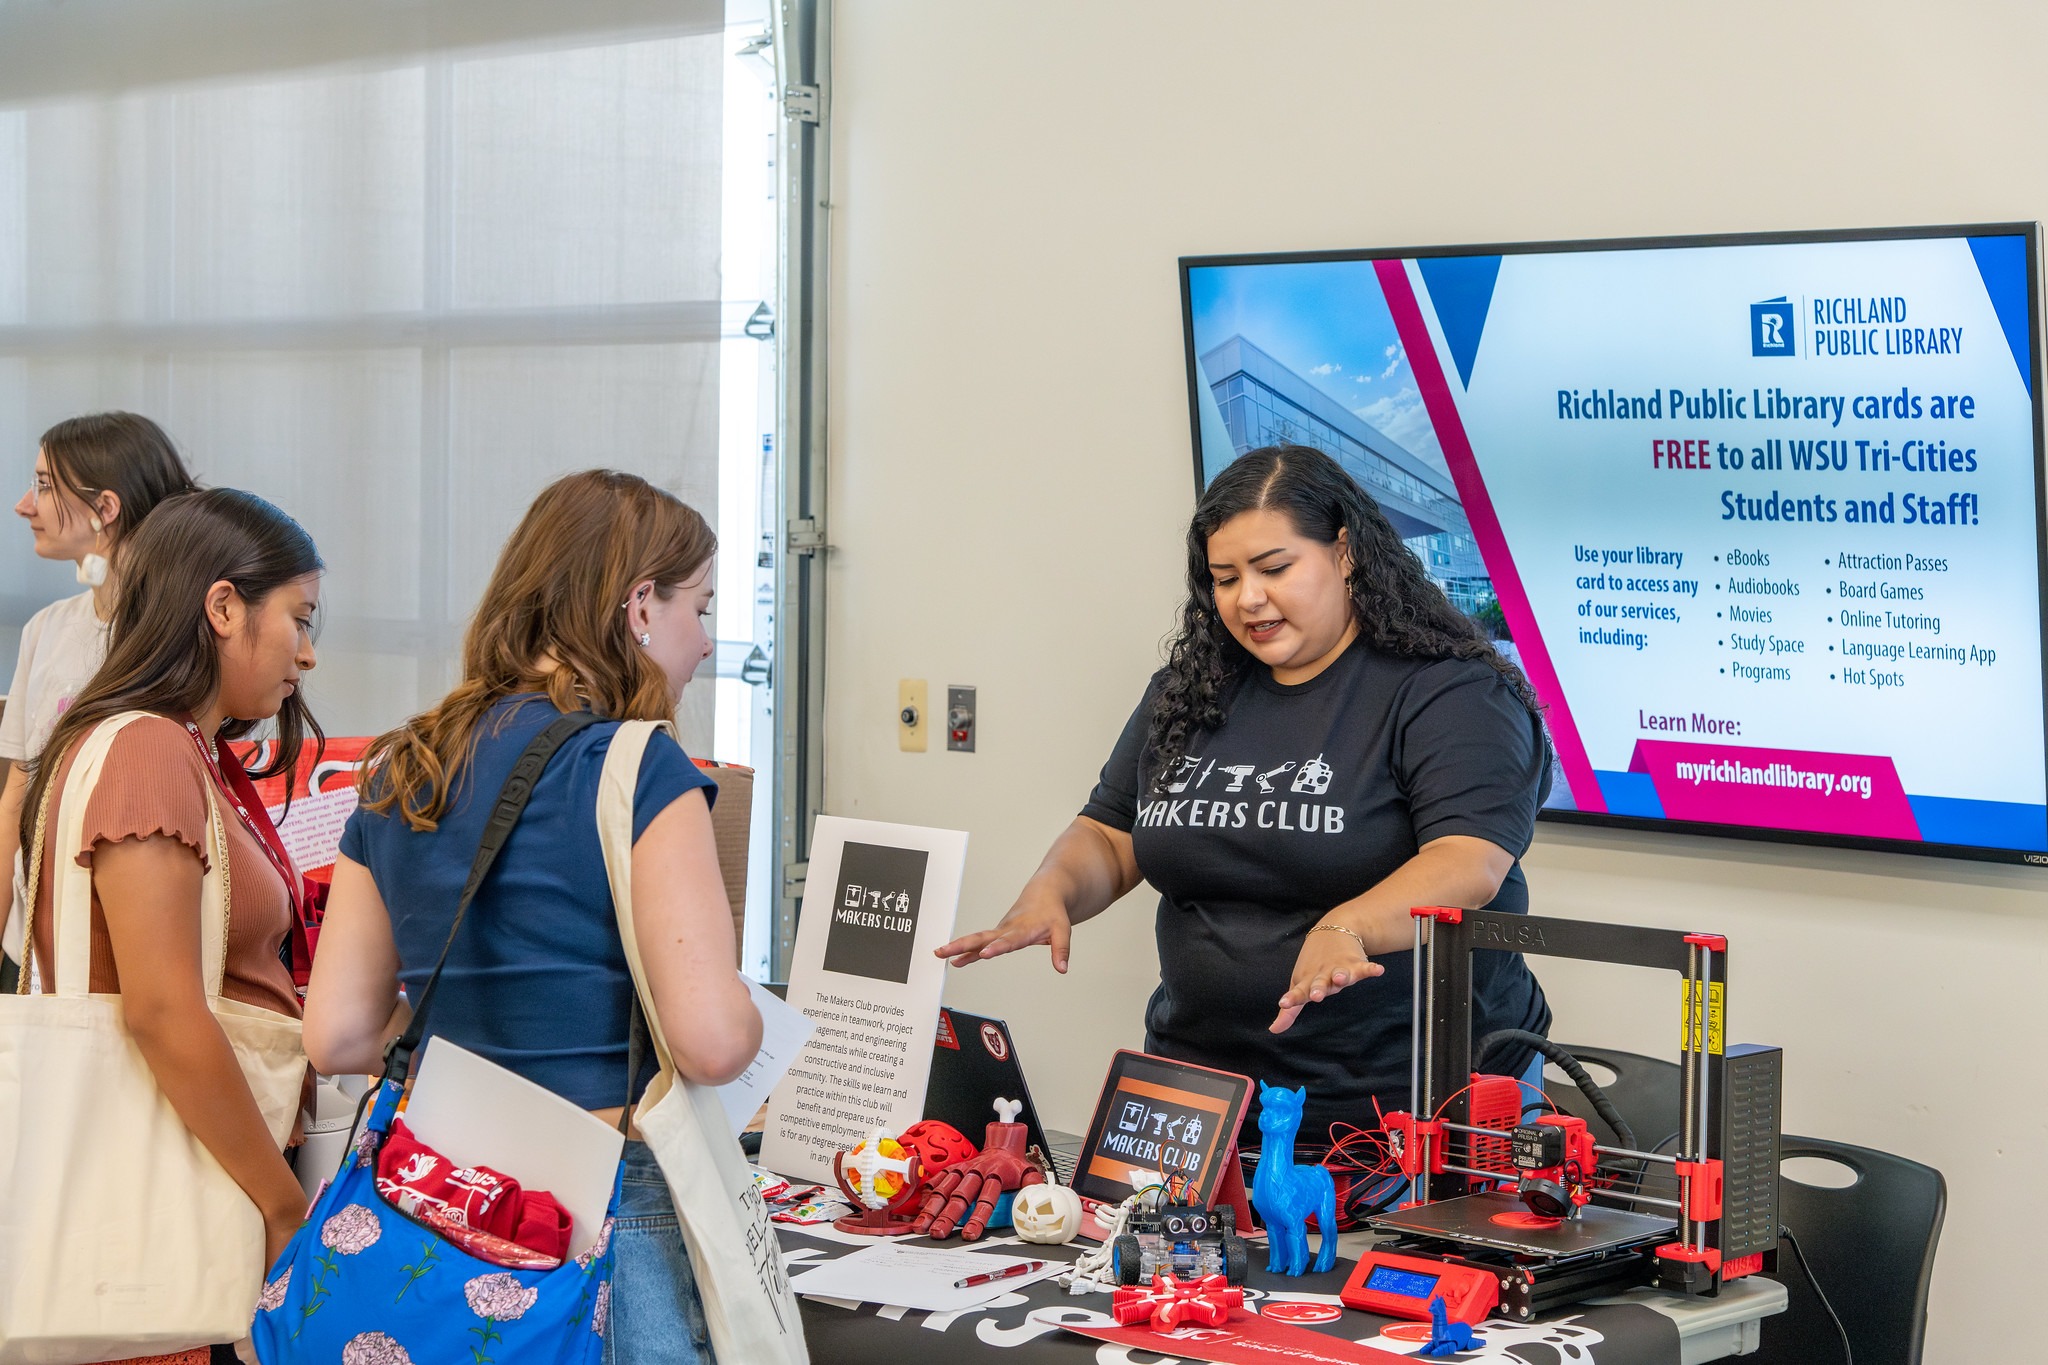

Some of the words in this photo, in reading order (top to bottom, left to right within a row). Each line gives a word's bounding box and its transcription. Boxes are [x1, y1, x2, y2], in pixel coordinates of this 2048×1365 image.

[1814, 297, 1906, 324] RICHLAND
[1816, 329, 1878, 356] PUBLIC
[1886, 328, 1962, 354] LIBRARY
[1558, 389, 1662, 419] Richland
[1670, 389, 1746, 419] Public
[1754, 388, 1845, 428] Library
[1853, 387, 1922, 419] cards
[1930, 396, 1975, 419] are
[1653, 440, 1711, 469] FREE
[1717, 443, 1743, 470] to
[1751, 440, 1782, 470] all
[1789, 440, 1847, 471] WSU
[1855, 440, 1977, 472] Tri-Cities
[1721, 490, 1837, 522] Students
[1845, 492, 1894, 523] and
[1903, 493, 1978, 525] Staff!
[1575, 545, 1598, 562] Use
[1602, 550, 1633, 567] your
[1637, 547, 1683, 569] library
[1727, 549, 1769, 566] eBooks
[1839, 552, 1901, 570] Attraction
[1906, 554, 1947, 571] Passes
[1577, 574, 1604, 589] card
[1609, 577, 1622, 590] to
[1627, 579, 1669, 592] access
[1673, 580, 1698, 597] any
[1729, 577, 1799, 595] Audiobooks
[1840, 581, 1876, 598] Board
[1881, 583, 1923, 600] Games
[1578, 601, 1591, 616] of
[1595, 605, 1618, 617] our
[1622, 604, 1680, 623] services,
[1730, 606, 1772, 623] Movies
[1841, 610, 1881, 627] Online
[1885, 612, 1940, 634] Tutoring
[1580, 628, 1647, 650] including:
[1731, 634, 1766, 655] Study
[1769, 637, 1804, 655] Space
[1843, 639, 1904, 661] Language
[1909, 642, 1965, 665] Learning
[1970, 645, 1995, 666] App
[1733, 662, 1790, 683] Programs
[1844, 668, 1865, 684] Hot
[1870, 669, 1904, 689] Spots
[1640, 710, 1686, 731] Learn
[1692, 713, 1741, 735] More:
[1677, 759, 1871, 799] myrichlandlibrary.org
[1135, 800, 1248, 828] MAKERS
[1257, 801, 1345, 834] CLUB
[2024, 854, 2048, 864] VIZIO
[835, 908, 881, 929] MAKERS
[883, 914, 913, 934] CLUB
[1473, 920, 1546, 947] PRUSA
[816, 992, 829, 1003] The
[829, 994, 854, 1008] Makers
[856, 1000, 872, 1011] Club
[873, 1004, 905, 1017] provides
[802, 1007, 840, 1021] experience
[841, 1012, 848, 1022] in
[849, 1015, 885, 1031] teamwork,
[886, 1023, 913, 1035] project
[815, 1026, 849, 1040] agement,
[850, 1031, 864, 1042] and
[865, 1035, 907, 1053] engineering
[804, 1039, 848, 1055] undamentals
[849, 1047, 868, 1059] while
[869, 1051, 898, 1067] creating
[899, 1057, 904, 1066] a
[804, 1055, 848, 1071] constructive
[848, 1063, 862, 1074] and
[863, 1065, 895, 1080] inclusive
[788, 1067, 828, 1083] community.
[829, 1074, 842, 1086] The
[843, 1077, 861, 1090] skills
[861, 1083, 872, 1092] we
[873, 1082, 892, 1096] learn
[893, 1089, 908, 1099] and
[796, 1085, 825, 1099] practice
[825, 1090, 847, 1103] within
[848, 1095, 861, 1106] this
[862, 1098, 879, 1110] club
[879, 1102, 893, 1113] will
[780, 1112, 821, 1130] competitive
[821, 1121, 867, 1140] employment.
[796, 1100, 822, 1114] benefit
[822, 1106, 836, 1117] and
[836, 1110, 865, 1124] prepare
[865, 1116, 874, 1125] us
[875, 1116, 887, 1128] for
[780, 1127, 786, 1138] is
[787, 1128, 798, 1140] for
[798, 1133, 811, 1145] any
[812, 1135, 857, 1153] degree-seeki
[1103, 1131, 1160, 1162] MAKERS
[1163, 1146, 1201, 1172] CLUB
[810, 1151, 817, 1160] in
[817, 1154, 831, 1166] any
[1232, 1341, 1284, 1353] School
